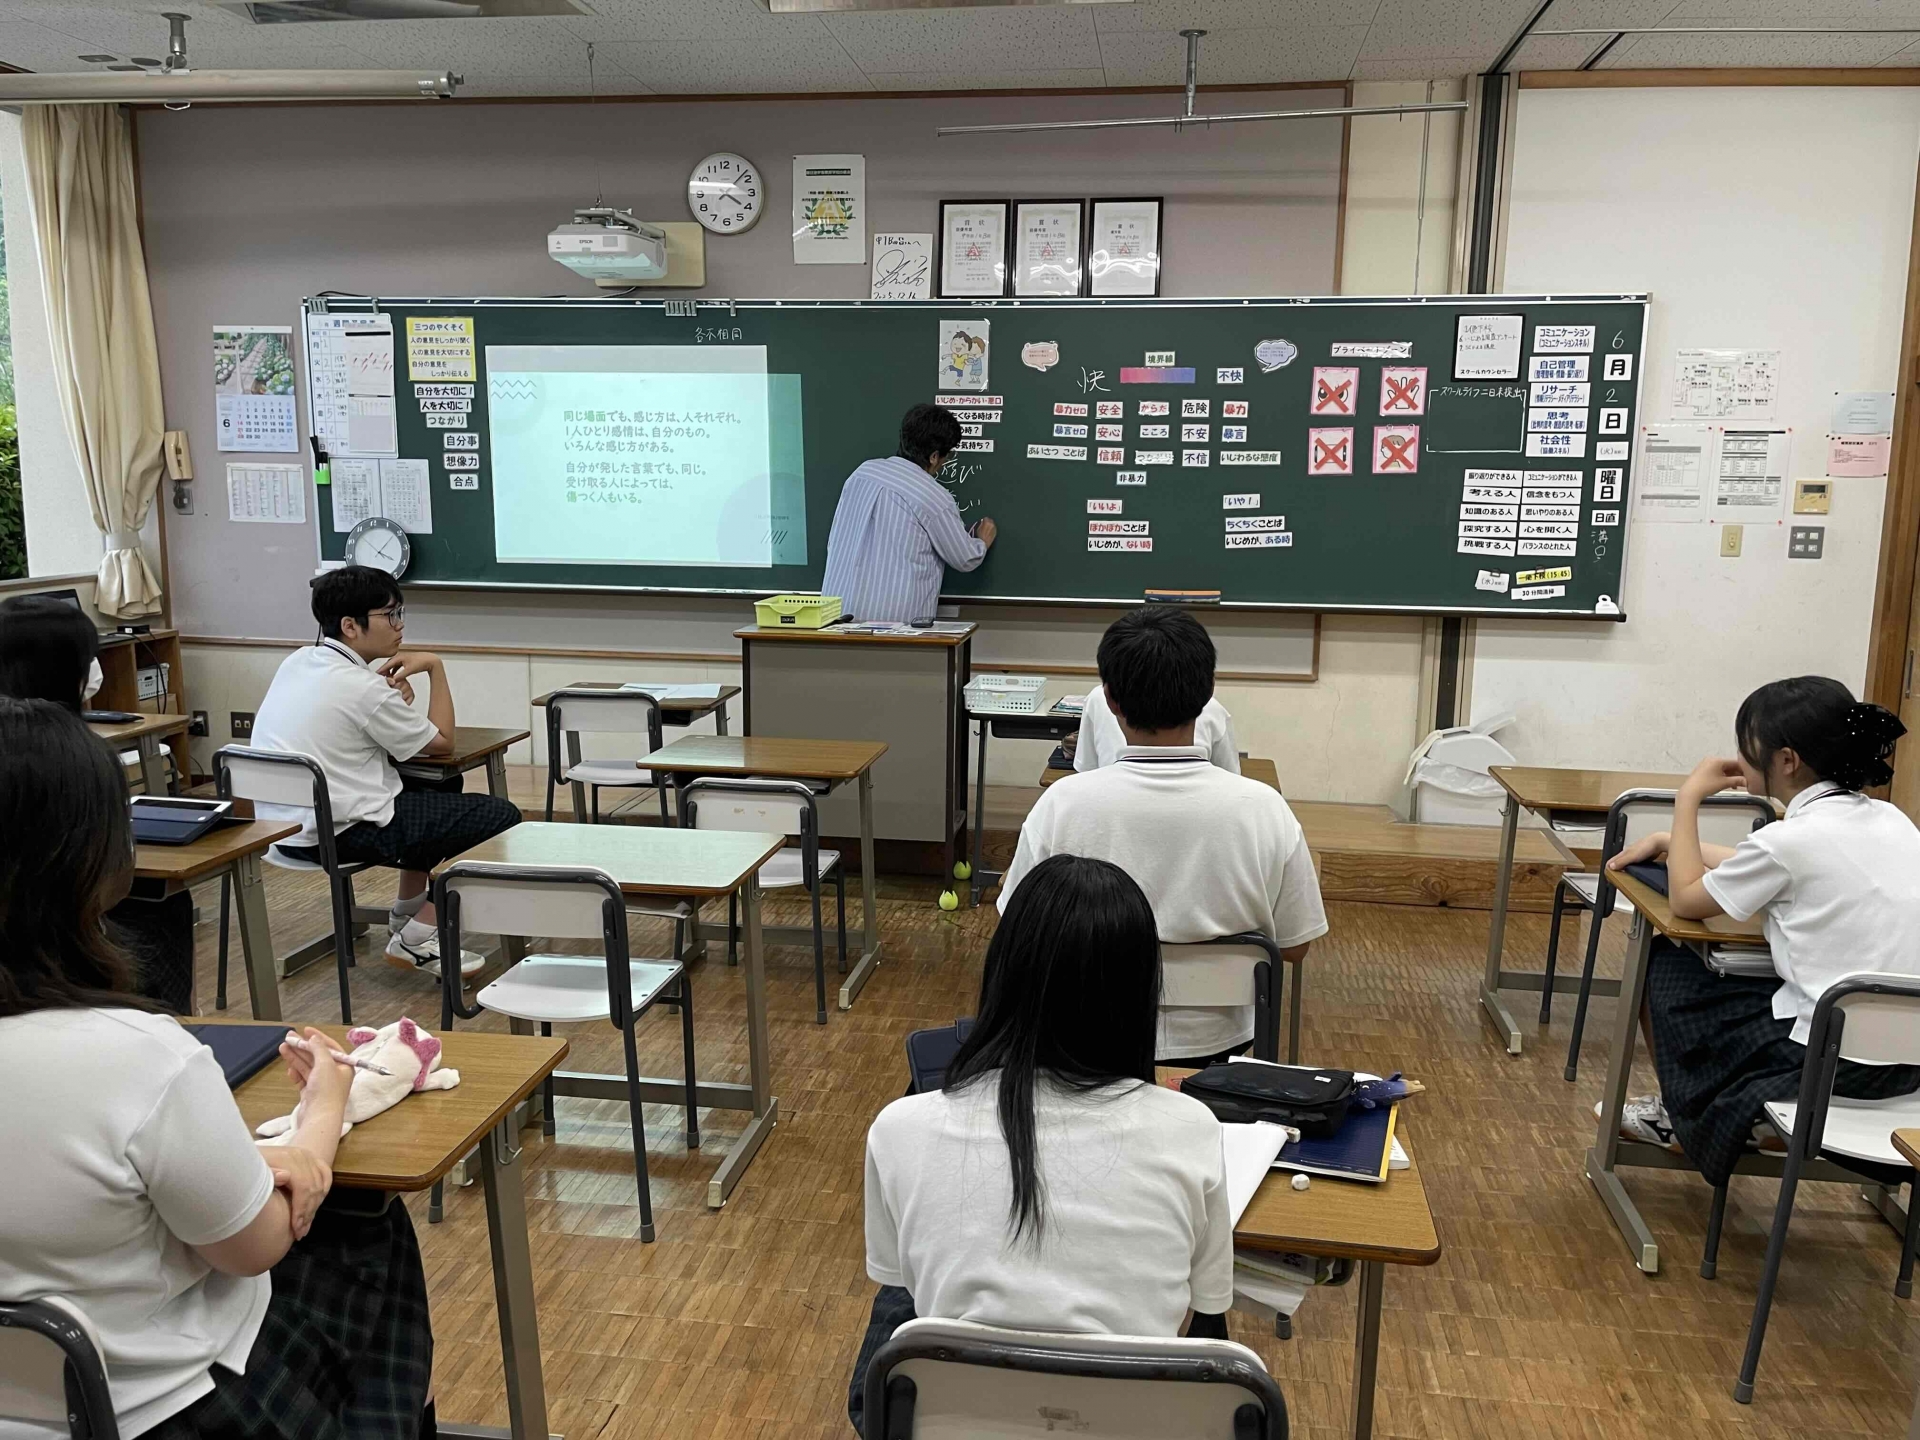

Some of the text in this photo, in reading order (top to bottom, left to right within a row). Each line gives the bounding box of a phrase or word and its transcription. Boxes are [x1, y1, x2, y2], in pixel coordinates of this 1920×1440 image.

[720, 161, 730, 169] 12
[736, 164, 740, 172] 1
[744, 175, 752, 183] 2
[748, 188, 756, 196] 3
[700, 204, 708, 212] 8
[710, 214, 718, 222] 7
[722, 218, 730, 226] 6
[736, 213, 744, 221] 5
[1540, 328, 1590, 337] コミュニケーション
[1612, 330, 1624, 350] 6
[1148, 355, 1174, 364] 境界線
[1540, 360, 1576, 369] 自己管理
[1610, 359, 1626, 376] 月
[1077, 366, 1112, 394] 快
[1218, 370, 1242, 382] 不快
[416, 386, 472, 396] 自分を大切に！
[1542, 385, 1577, 394] リサーチ
[1606, 388, 1618, 402] 2
[422, 401, 469, 410] 人を大切に！
[1055, 404, 1086, 414] 暴力ゼロ
[1098, 404, 1121, 416] 安全
[1141, 404, 1167, 412] からだ
[1184, 402, 1208, 414] 危険
[1224, 404, 1246, 415] 暴力
[428, 416, 464, 426] つながり
[564, 410, 742, 424] 同じ場面でも、感じ方は、人それぞれ。
[1547, 412, 1570, 420] 思考
[223, 418, 230, 428] 6
[1605, 414, 1620, 429] 日
[566, 426, 710, 438] 1人ひとり感情は、自分のもの。
[1054, 426, 1086, 435] 暴言ゼロ
[1097, 427, 1120, 438] 安心
[1142, 428, 1168, 436] こころ
[1184, 428, 1207, 439] 不安
[1224, 428, 1245, 439] 暴言
[447, 436, 477, 446] 自分事
[1540, 436, 1571, 445] 社会性
[564, 440, 674, 453] いろんな感じ方がある。
[1029, 446, 1086, 458] あいさつ ことば
[1099, 451, 1122, 462] 信頼
[446, 456, 477, 466] 想像力
[1184, 453, 1208, 464] 不信
[1222, 453, 1278, 462] いじわるな態度
[566, 462, 706, 476] 自分が発した言葉でも、同じ。
[1120, 474, 1144, 482] 非暴力
[1468, 472, 1516, 480] 振り返りができる人
[454, 476, 474, 487] 合点
[566, 476, 674, 490] 受け取る人によっては、
[1601, 470, 1616, 500] 曜日
[566, 491, 642, 504] 傷つく人もいる。
[1469, 488, 1516, 498] 考える人
[1224, 496, 1258, 506] 「いや！」
[1088, 502, 1121, 512] 「いいよ」
[1465, 508, 1512, 516] 知識のある人
[1595, 513, 1616, 522] 日直
[1227, 519, 1282, 529] ちくちくことば
[1464, 525, 1511, 533] 探究する人
[1226, 535, 1290, 546] いじめが、ある時
[1464, 540, 1512, 550] 挑戦する人
[1522, 542, 1571, 550] バランスのとれた人
